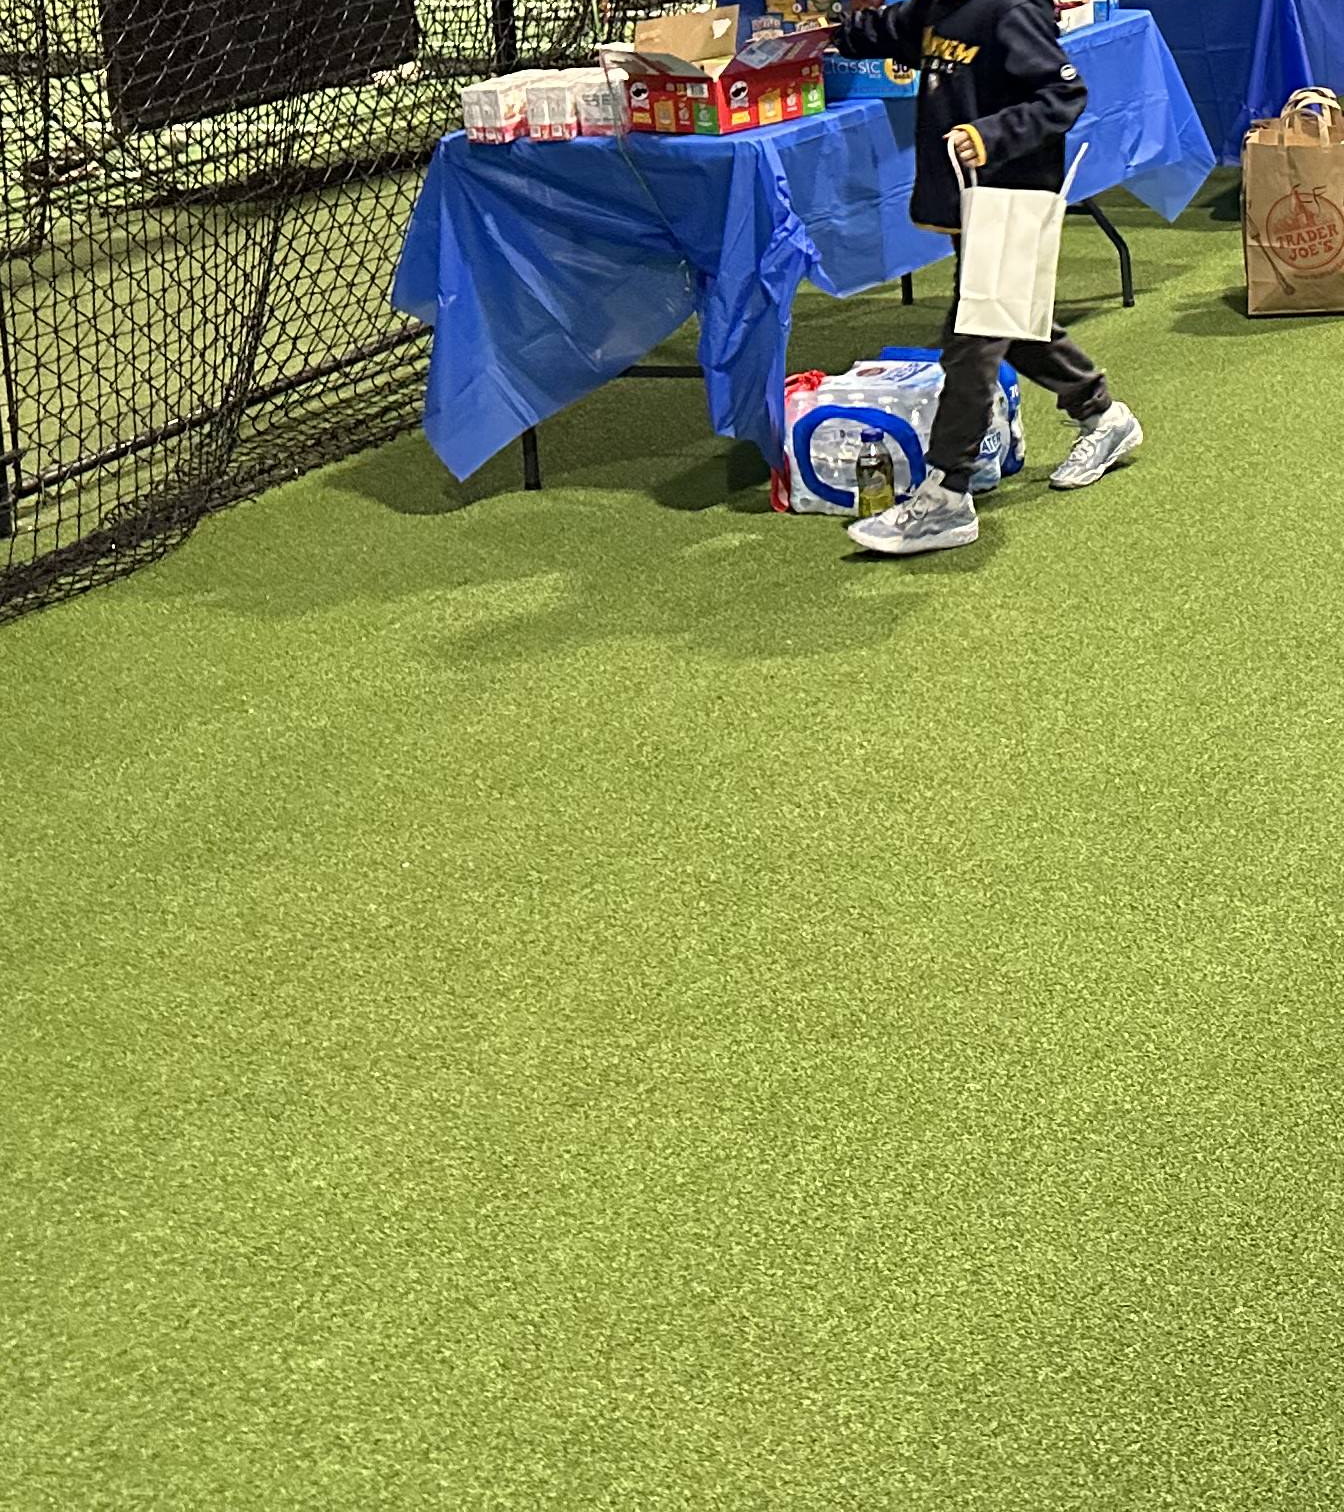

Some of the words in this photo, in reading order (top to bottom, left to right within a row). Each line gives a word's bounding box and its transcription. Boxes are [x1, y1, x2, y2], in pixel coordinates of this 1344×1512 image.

[1275, 223, 1339, 249] TRADER
[1288, 239, 1335, 262] JOE'S
[981, 431, 1002, 453] ATER
